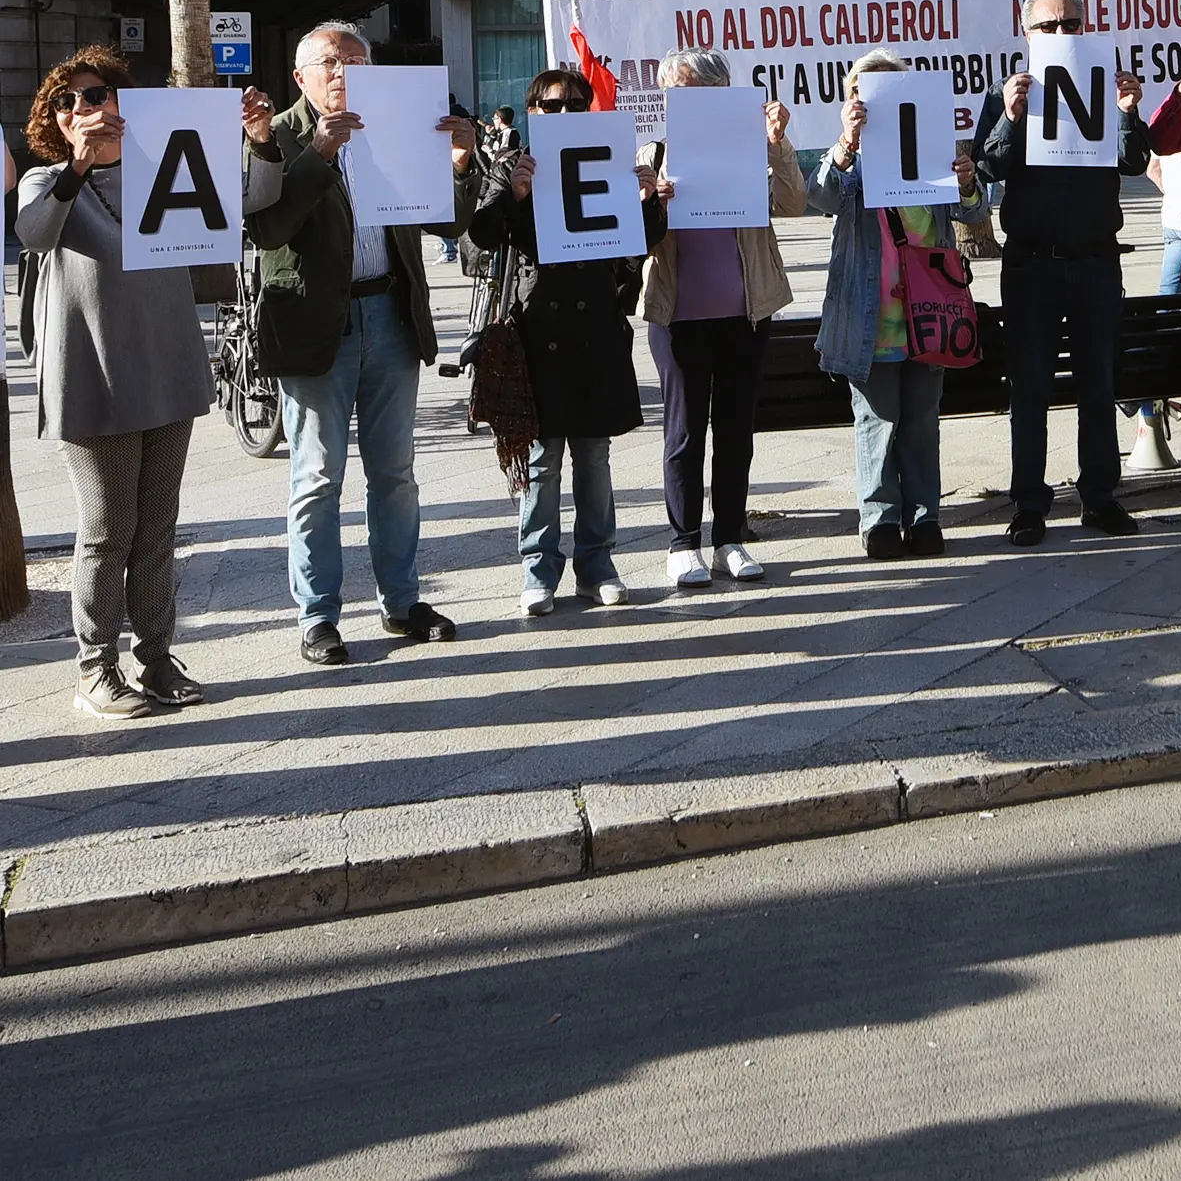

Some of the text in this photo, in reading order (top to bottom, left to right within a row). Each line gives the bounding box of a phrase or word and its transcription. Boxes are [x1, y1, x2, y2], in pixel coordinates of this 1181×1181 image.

[675, 8, 714, 50] NO
[722, 7, 755, 50] AL
[761, 5, 813, 49] DDL
[819, 0, 959, 47] CALDEROLI
[222, 46, 236, 62] P
[793, 63, 812, 105] A
[812, 61, 853, 104] UN
[1131, 45, 1146, 84] E
[1042, 65, 1105, 142] N
[899, 102, 919, 181] I
[138, 129, 228, 235] A
[560, 145, 619, 233] E
[173, 243, 215, 252] INDIVISIBILE
[583, 240, 621, 248] INDIVISIBILE
[911, 301, 963, 317] FIORUCCI
